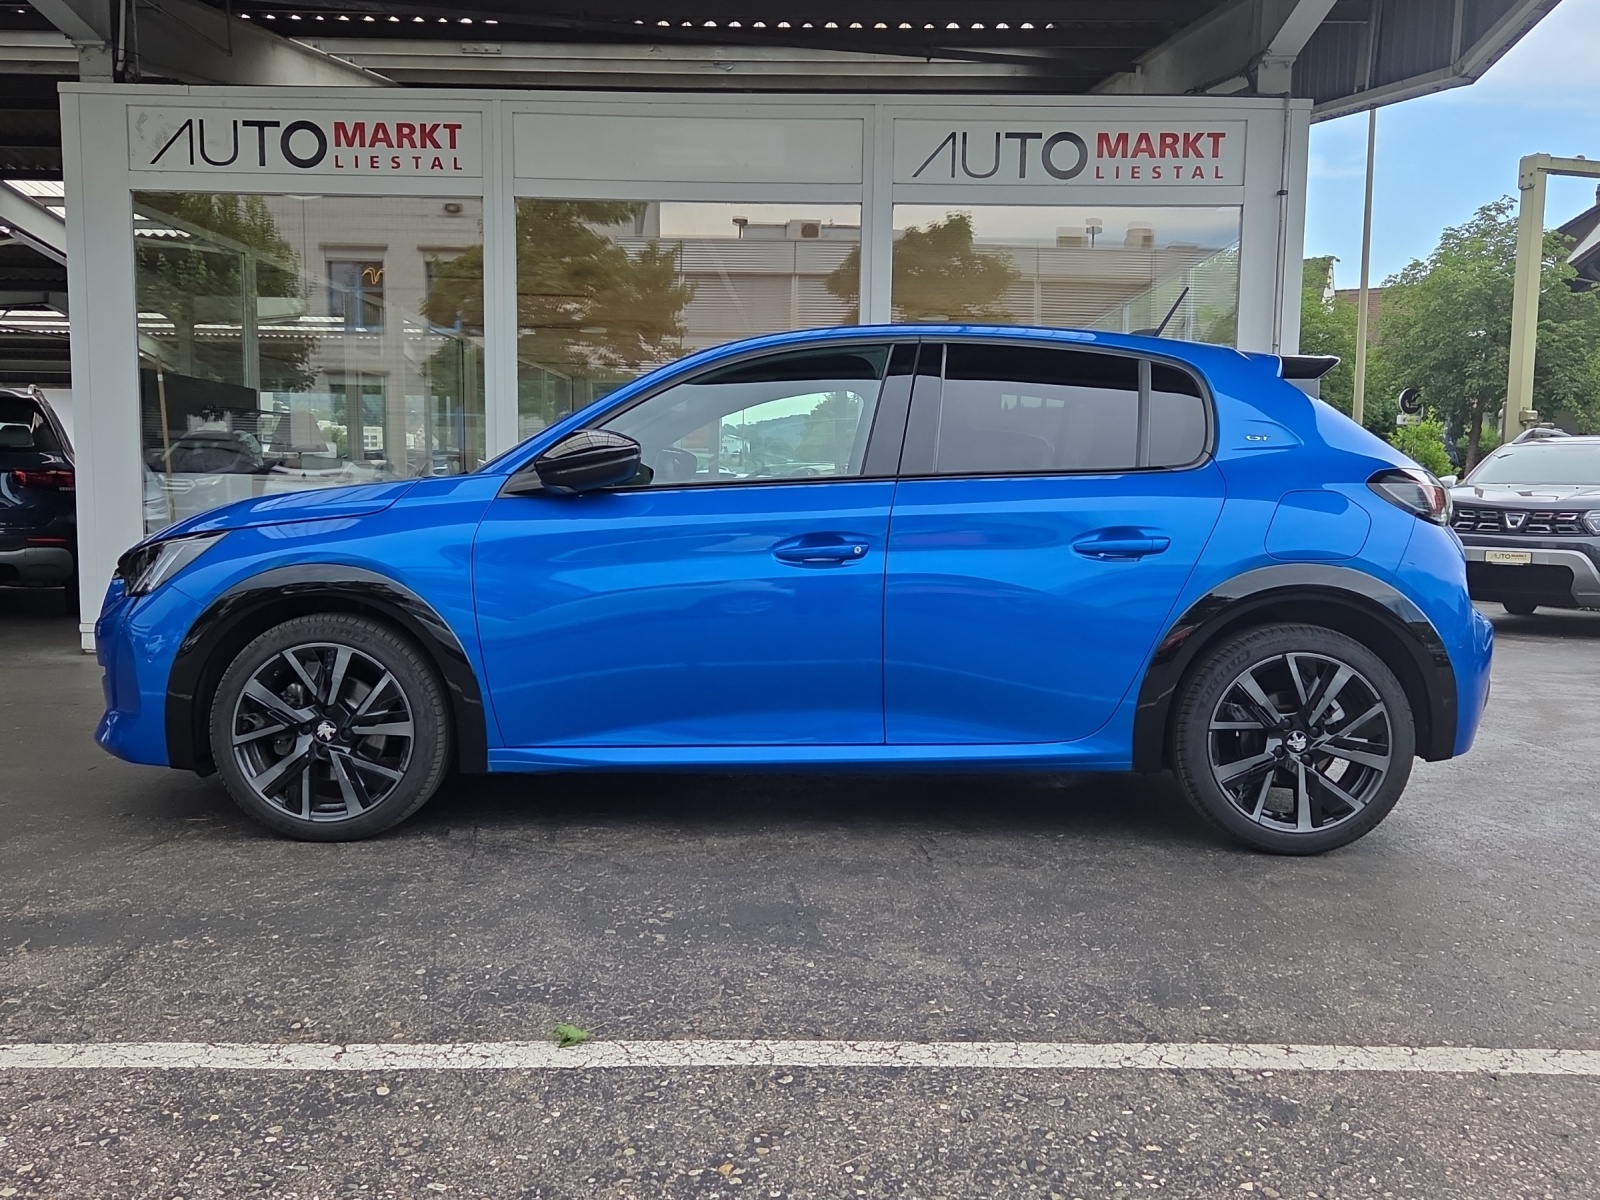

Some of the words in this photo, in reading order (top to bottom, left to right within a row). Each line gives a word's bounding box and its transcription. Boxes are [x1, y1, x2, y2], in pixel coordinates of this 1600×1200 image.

[150, 118, 328, 169] AUTO
[333, 121, 463, 150] MARKT
[911, 131, 1089, 180] AUTO
[1096, 132, 1226, 158] MARKT
[334, 154, 463, 171] LIESTAL
[1095, 165, 1225, 180] LIESTAL
